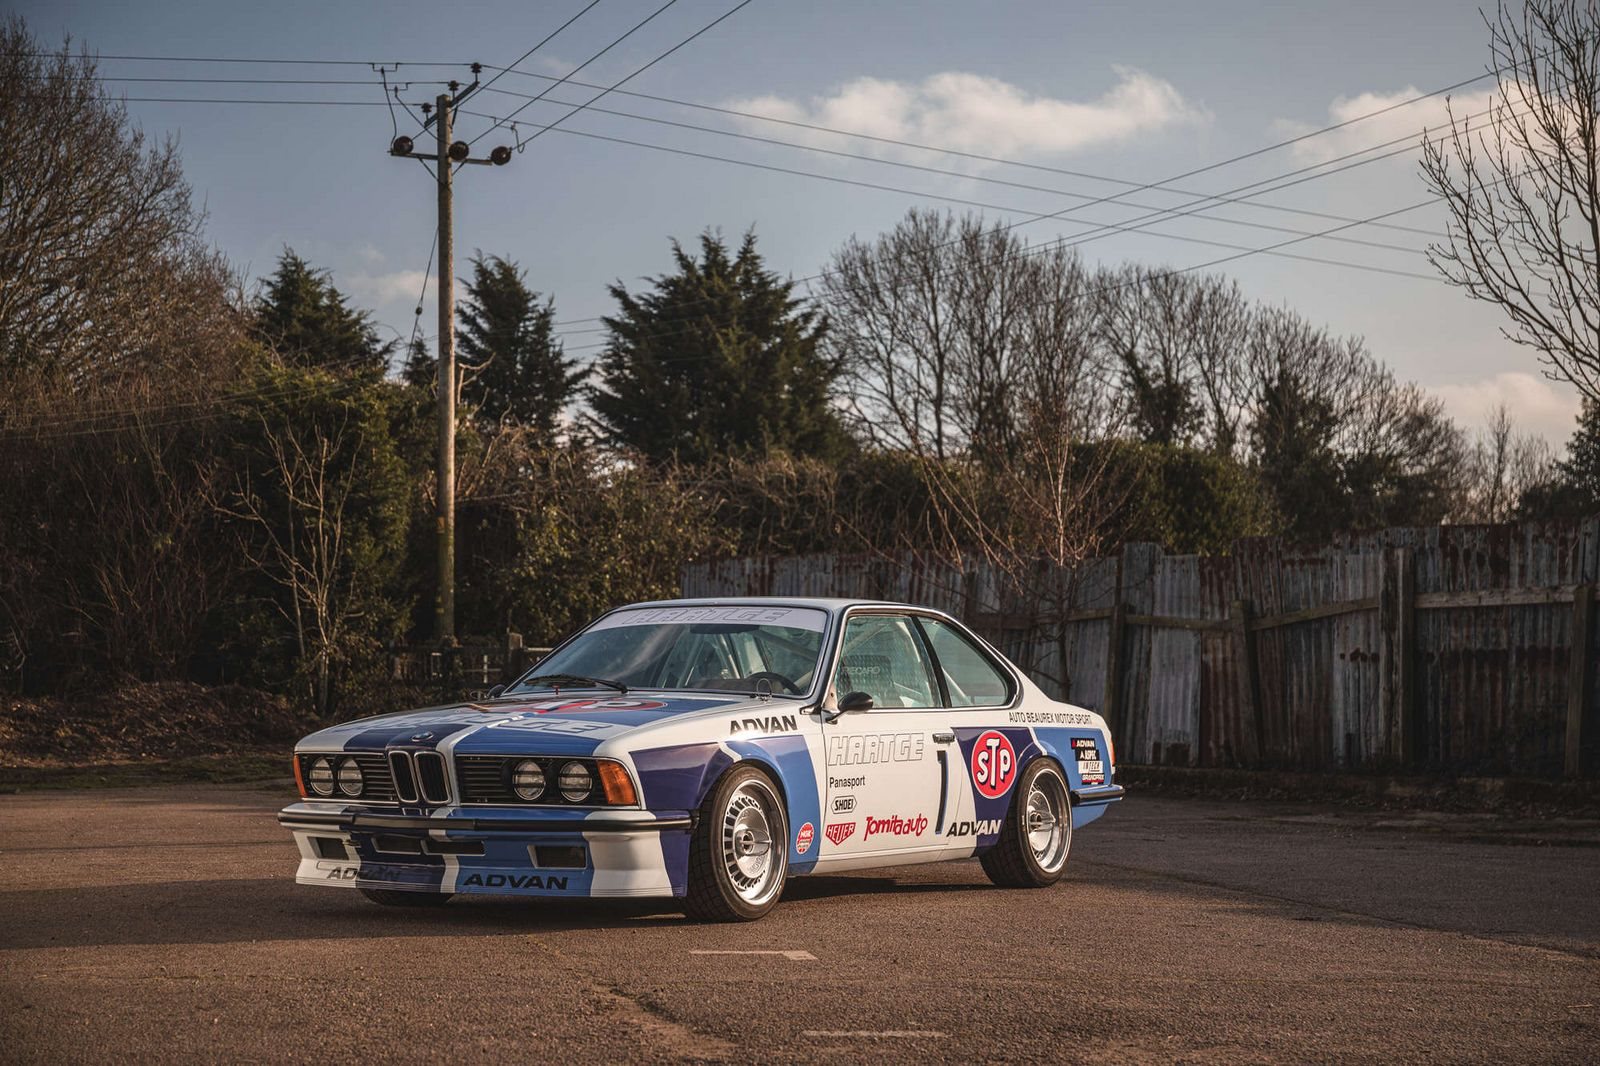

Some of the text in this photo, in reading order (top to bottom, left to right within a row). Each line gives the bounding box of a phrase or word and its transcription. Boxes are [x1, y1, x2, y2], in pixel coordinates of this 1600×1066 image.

[622, 607, 792, 625] HARTGE
[730, 715, 798, 734] ADVAN
[1008, 712, 1093, 725] AUTO BEAUREX MOTOR SPORT
[827, 732, 925, 766] HARTGE
[1076, 739, 1095, 748] ADVAN
[976, 738, 1012, 790] STP
[829, 776, 866, 789] Panasport
[834, 799, 854, 811] SHOEI
[827, 823, 855, 844] HEUER
[946, 819, 1002, 837] ADVAN
[463, 873, 569, 890] ADVAN
